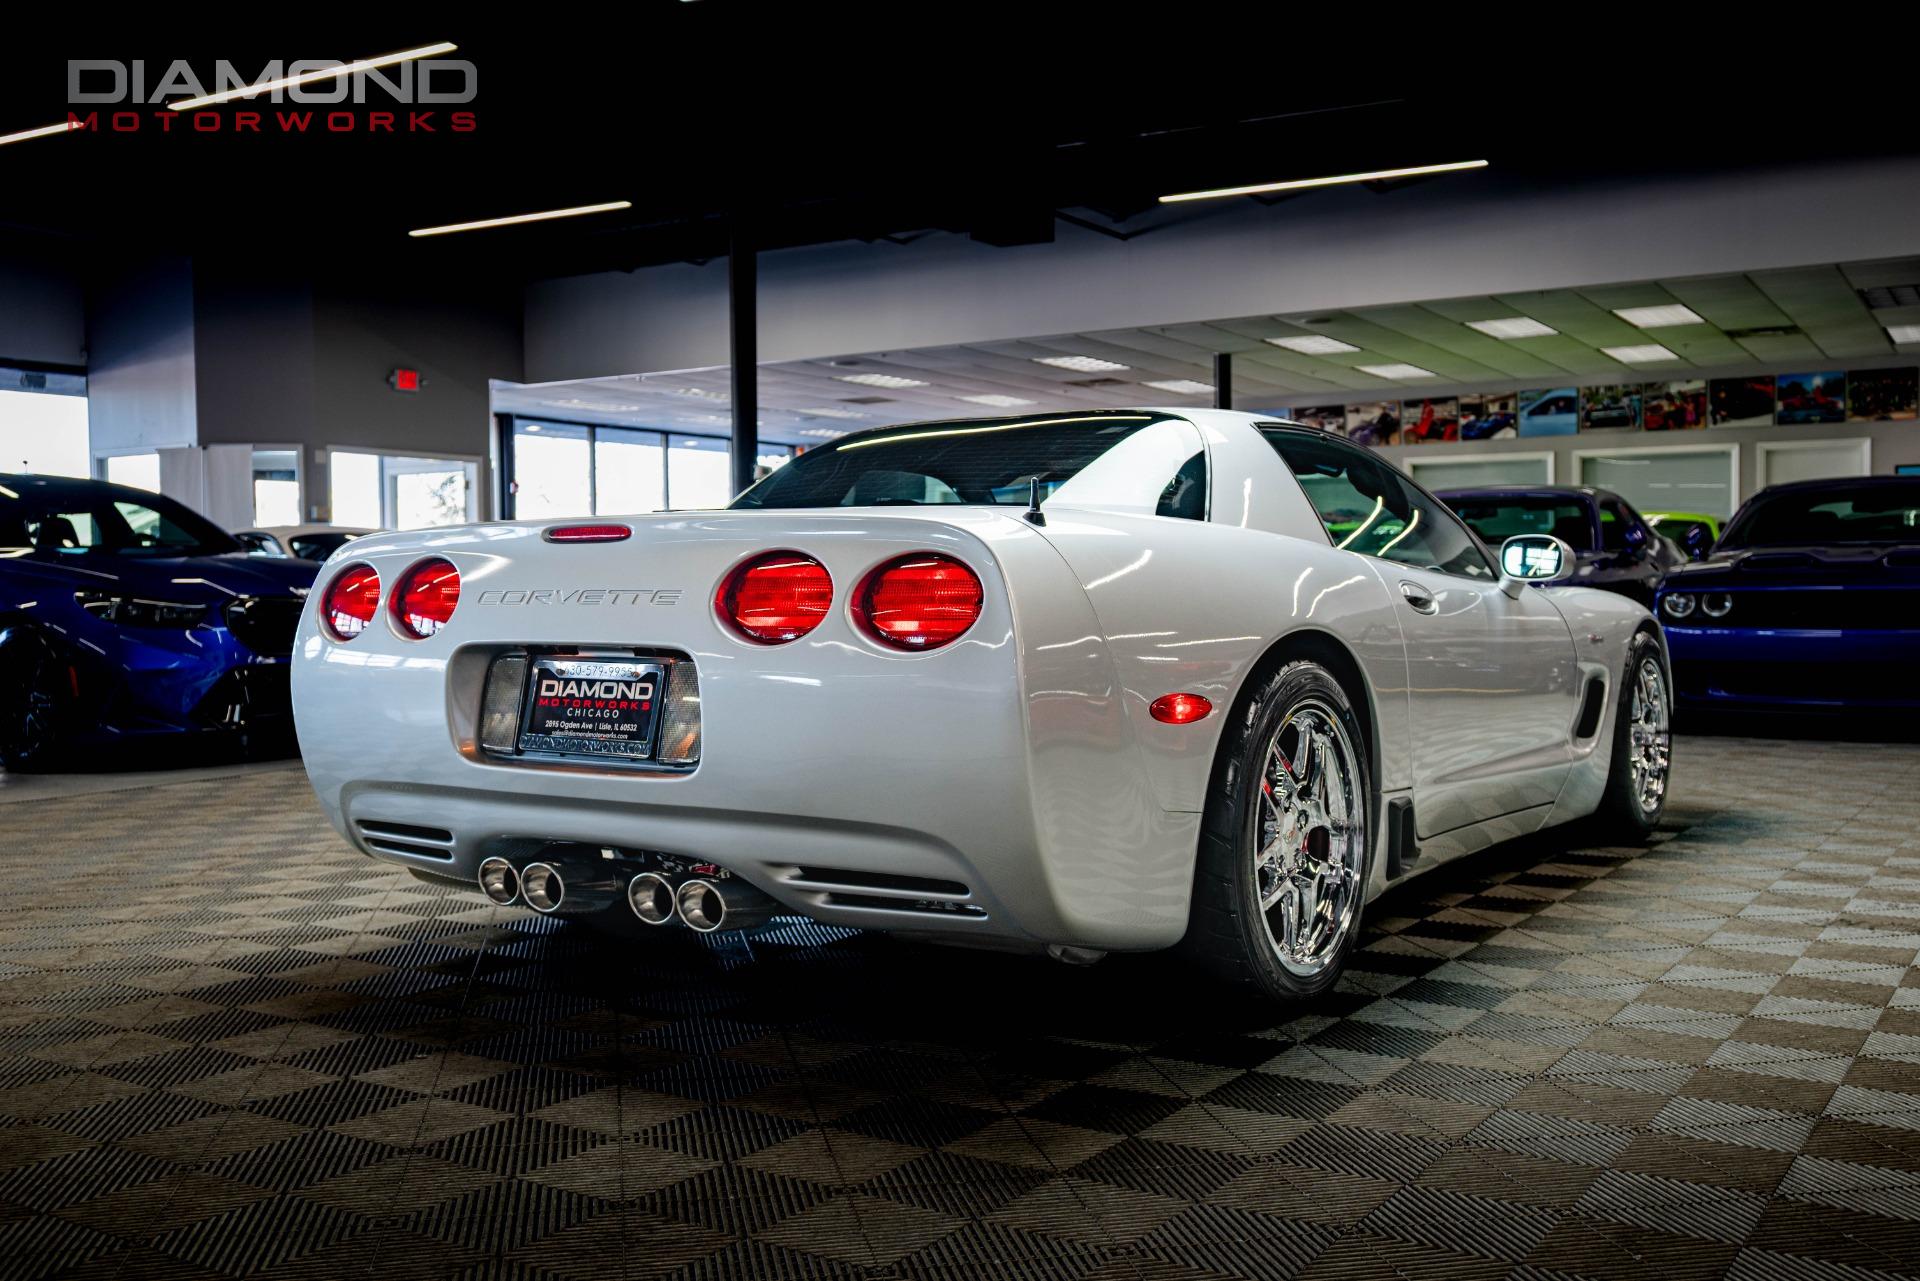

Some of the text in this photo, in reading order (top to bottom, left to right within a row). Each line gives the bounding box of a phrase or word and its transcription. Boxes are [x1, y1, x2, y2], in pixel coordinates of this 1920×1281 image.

[477, 589, 683, 606] CORVETTE
[540, 679, 653, 700] DIAMOND
[538, 697, 651, 711] MOTORWORKS
[566, 707, 620, 719] CHICAGO
[560, 721, 580, 730] Ogden
[581, 721, 593, 730] Ave
[620, 723, 638, 732] 60532
